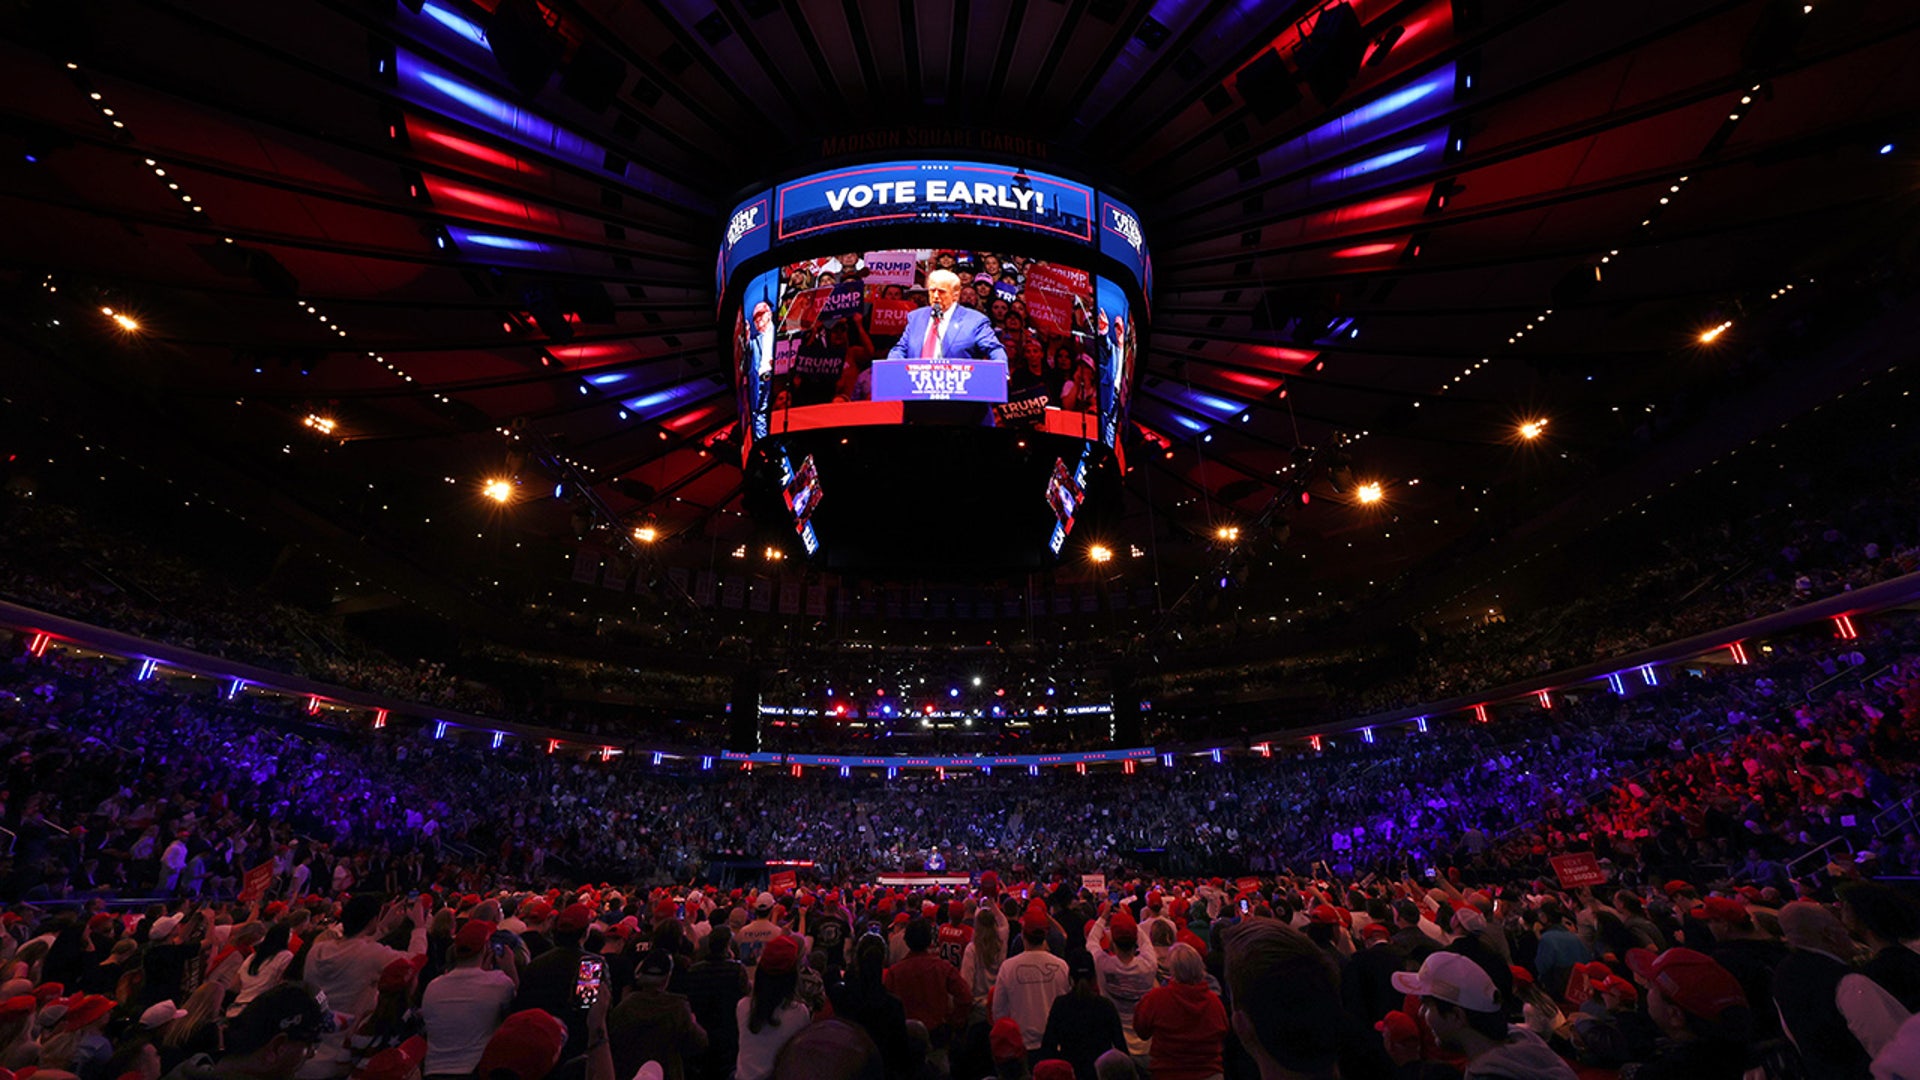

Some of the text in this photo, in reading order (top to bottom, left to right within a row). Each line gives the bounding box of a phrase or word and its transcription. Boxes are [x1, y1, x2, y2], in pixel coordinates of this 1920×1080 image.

[821, 126, 1048, 161] MADISON SQUARE GARDEN
[825, 180, 1045, 214] VOTE EARLY!
[868, 262, 912, 271] TRUMP
[815, 291, 861, 306] TRUMP
[798, 355, 842, 368] TRUMP
[908, 371, 972, 382] TRUMP
[915, 380, 965, 391] VANCE
[998, 395, 1049, 413] TRUMP
[940, 942, 962, 968] 45
